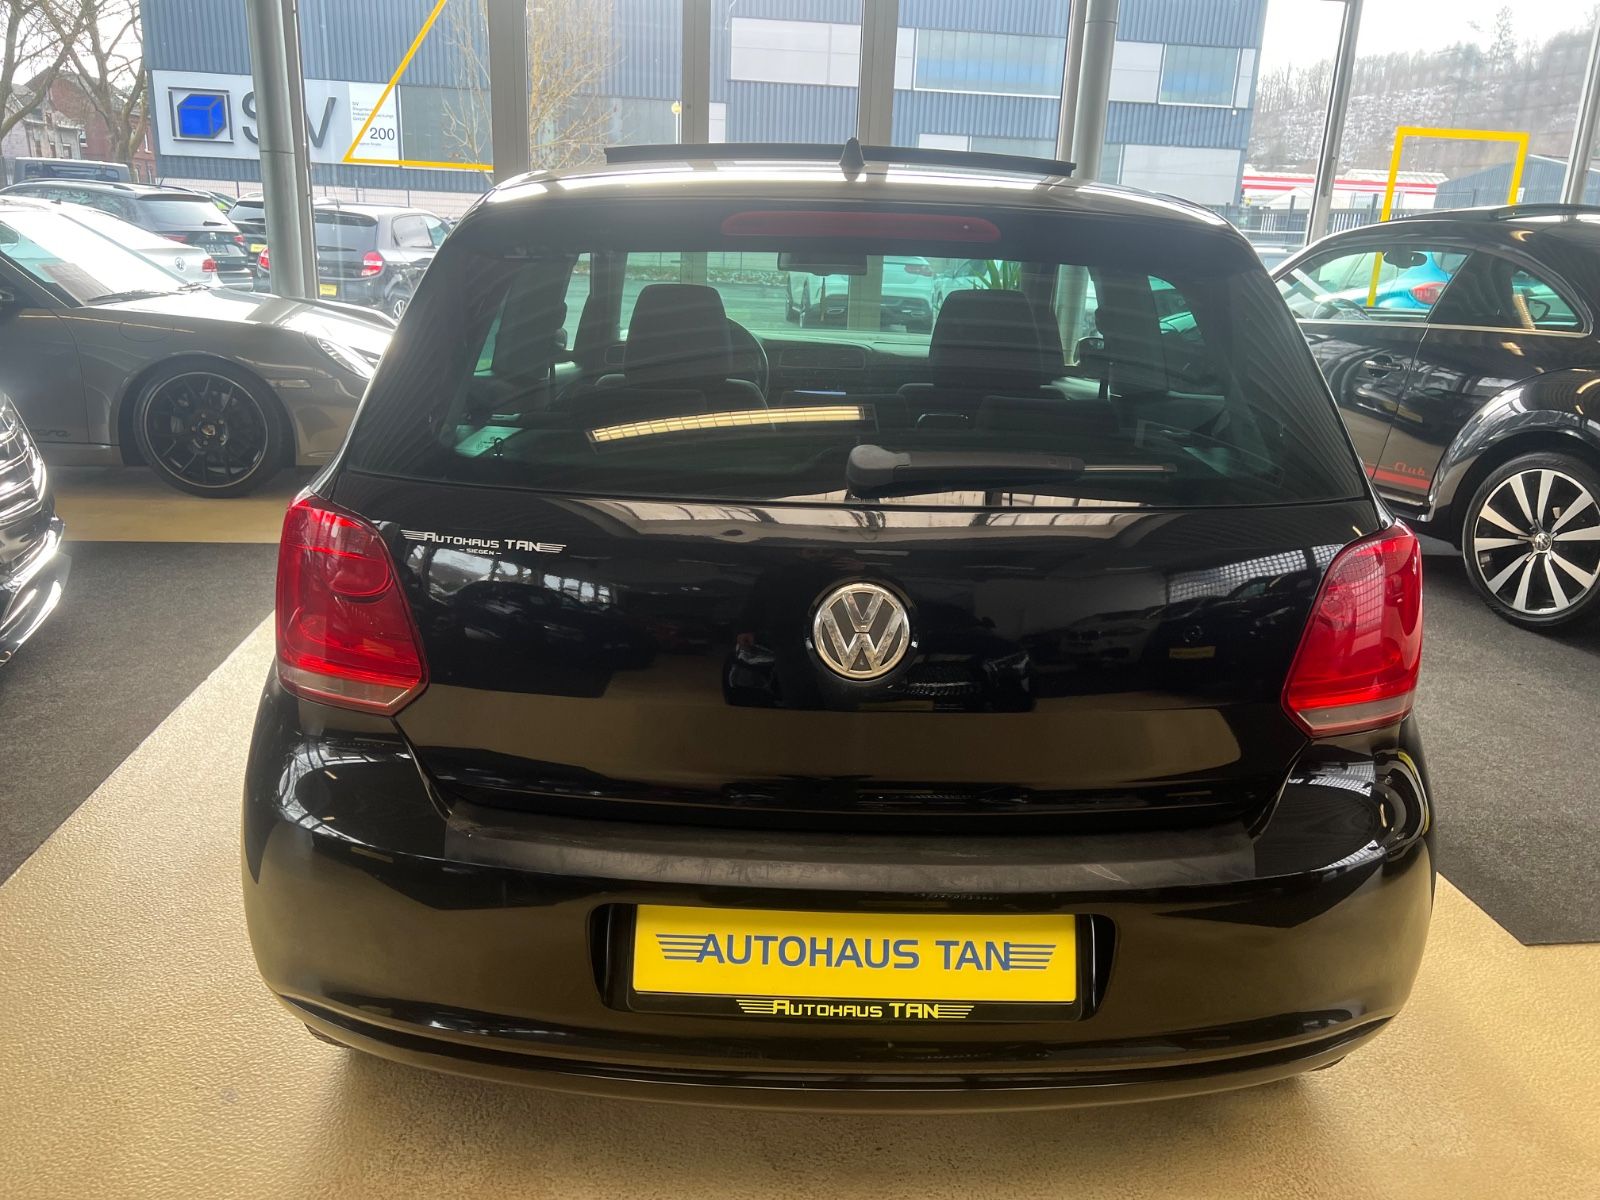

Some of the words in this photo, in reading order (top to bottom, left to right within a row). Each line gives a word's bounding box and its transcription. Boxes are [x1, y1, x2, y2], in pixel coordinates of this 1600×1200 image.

[370, 127, 395, 141] 200
[466, 547, 495, 556] SIEGEN
[504, 539, 542, 552] TAN
[697, 933, 920, 970] AUTOHAUS
[936, 941, 1011, 971] TAN
[889, 1003, 940, 1019] TAN
